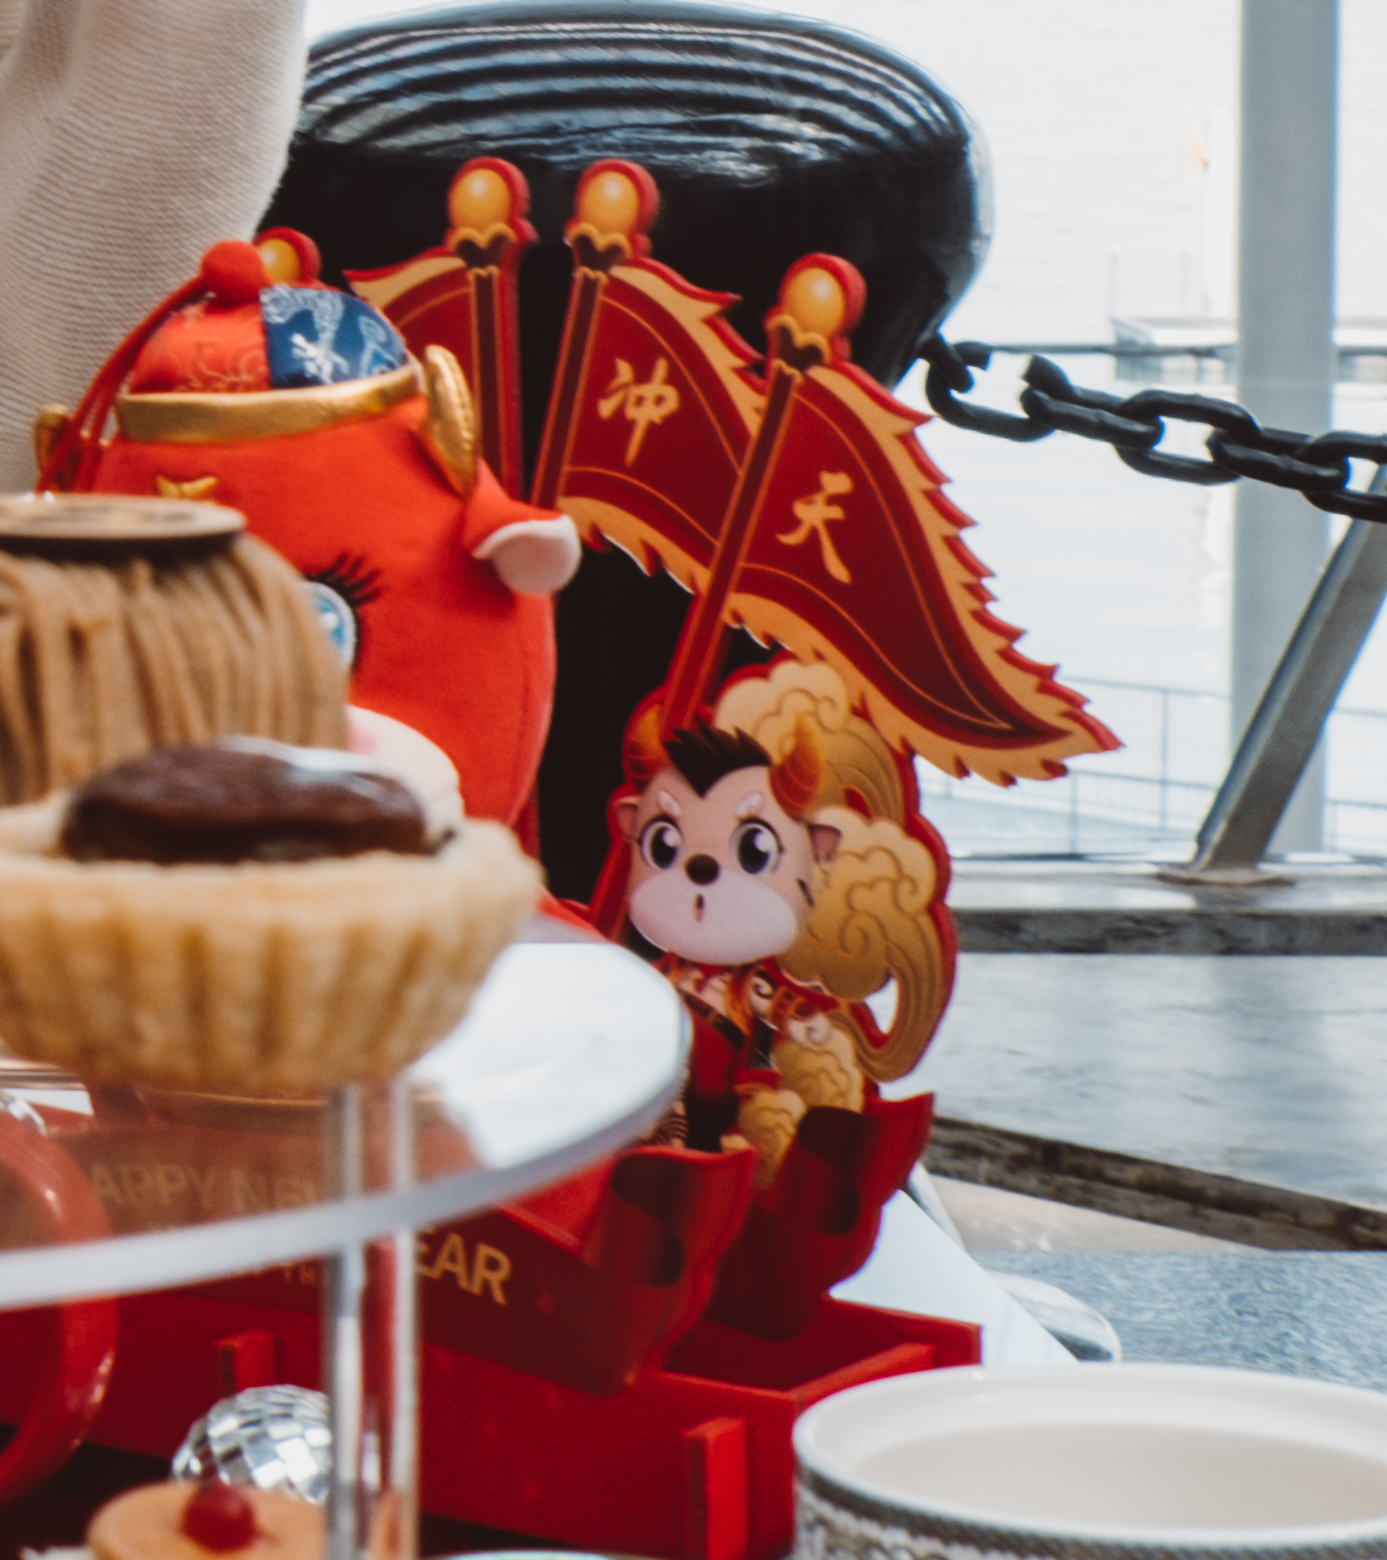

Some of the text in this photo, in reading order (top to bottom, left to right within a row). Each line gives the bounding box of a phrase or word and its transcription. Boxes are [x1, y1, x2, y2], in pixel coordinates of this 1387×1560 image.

[596, 356, 680, 469] 冲
[774, 470, 855, 585] 天
[86, 1161, 215, 1212] APPY
[416, 1226, 514, 1307] EAR
